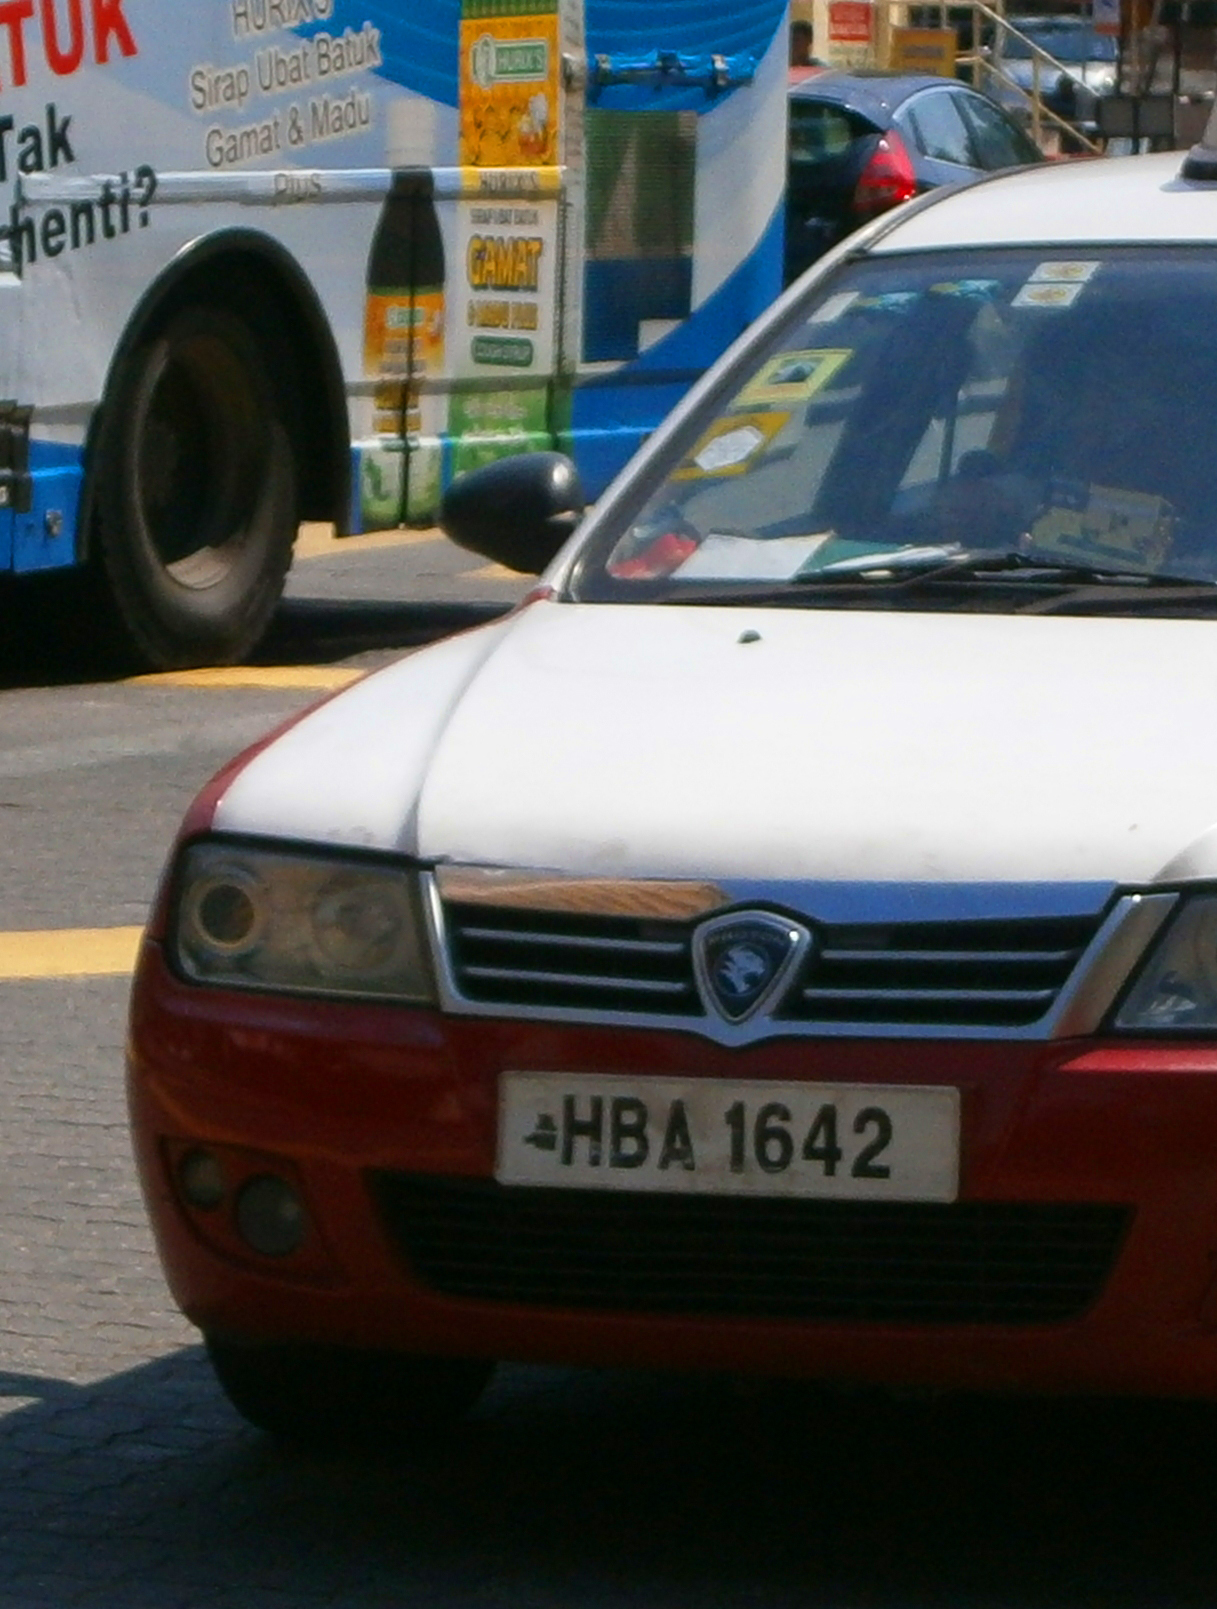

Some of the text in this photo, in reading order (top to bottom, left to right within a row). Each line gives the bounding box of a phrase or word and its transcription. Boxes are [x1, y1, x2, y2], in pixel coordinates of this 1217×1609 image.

[191, 28, 379, 110] Sirap Ubat Batuk
[206, 92, 370, 167] Gamat & Madu
[467, 234, 543, 293] GAMAT
[560, 1094, 894, 1179] HBA 1642
